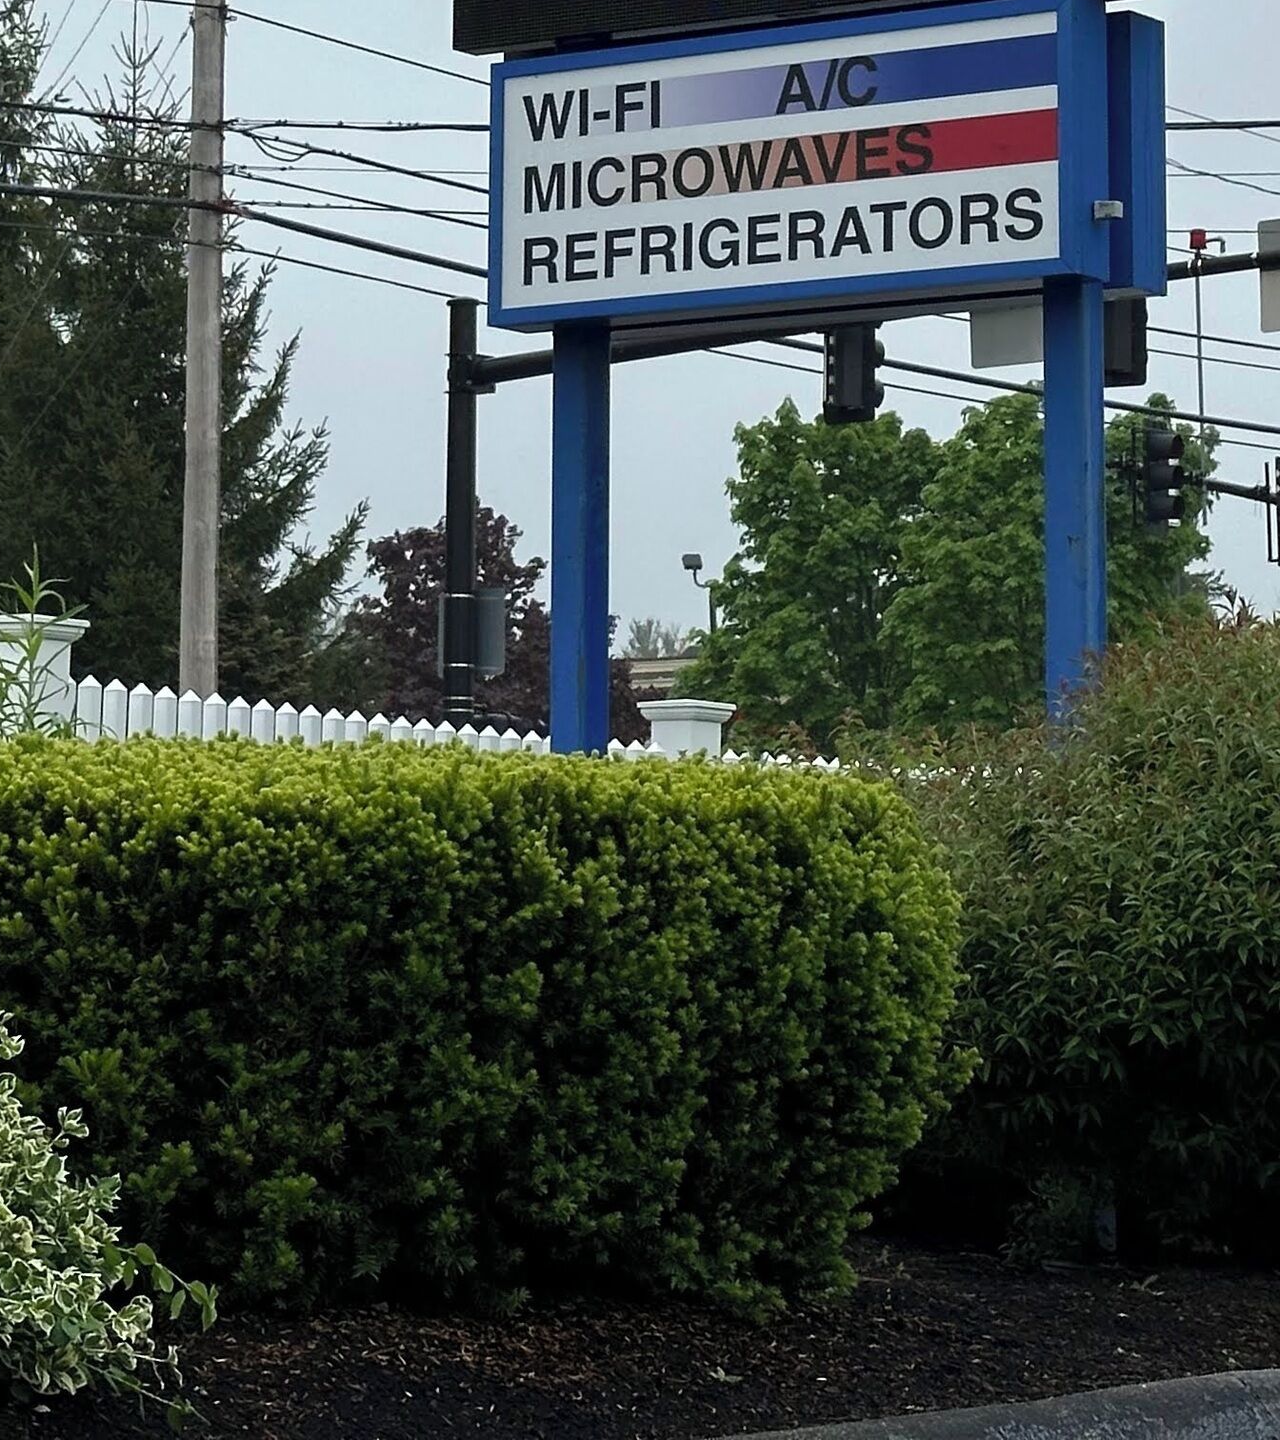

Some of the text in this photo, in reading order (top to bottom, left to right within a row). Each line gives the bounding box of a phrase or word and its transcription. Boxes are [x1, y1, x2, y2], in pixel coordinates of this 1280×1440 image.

[522, 55, 878, 143] WI-FI A/C
[523, 122, 934, 214] MICROWAVES
[523, 186, 1044, 287] REFRIGERATORS
